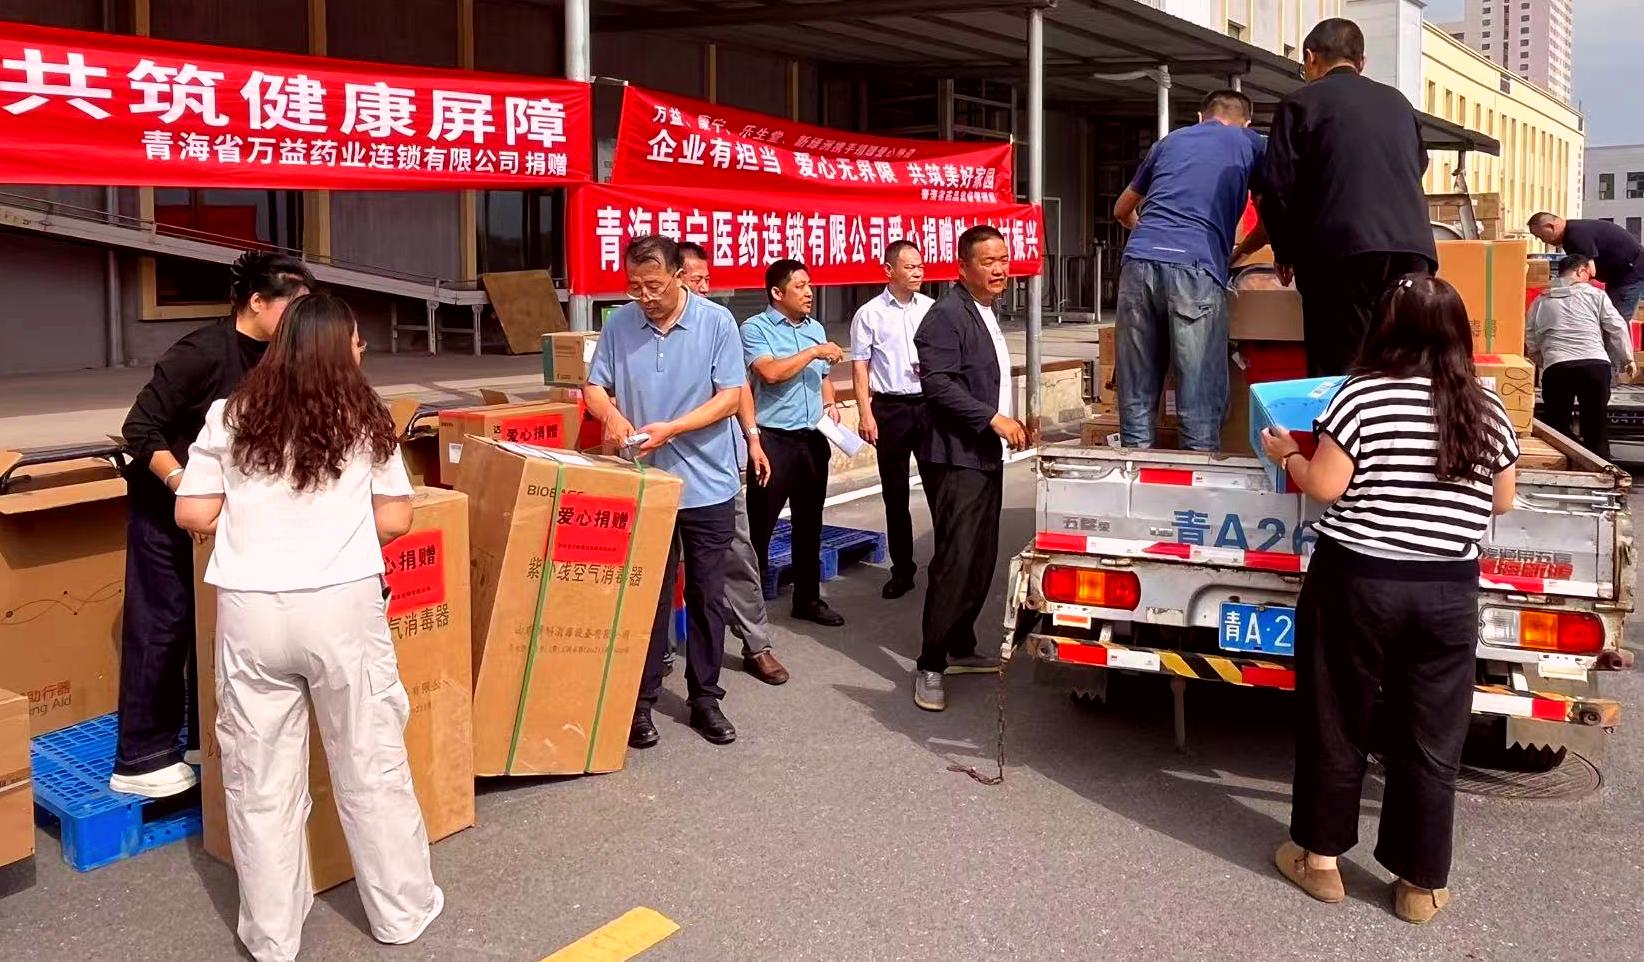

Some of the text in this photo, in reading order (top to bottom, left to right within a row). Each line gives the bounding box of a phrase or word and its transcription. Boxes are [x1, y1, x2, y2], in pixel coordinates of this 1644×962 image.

[1, 48, 567, 148] 共筑健康屏障
[140, 129, 568, 177] 青海省万益药业连锁有限公司 捐赠
[646, 129, 996, 190] 企业有担当 爱心无界限 共筑美好家园
[506, 424, 558, 442] 爱心捐赠
[557, 507, 628, 529] 爱心捐赠
[20, 680, 72, 703] 助行器
